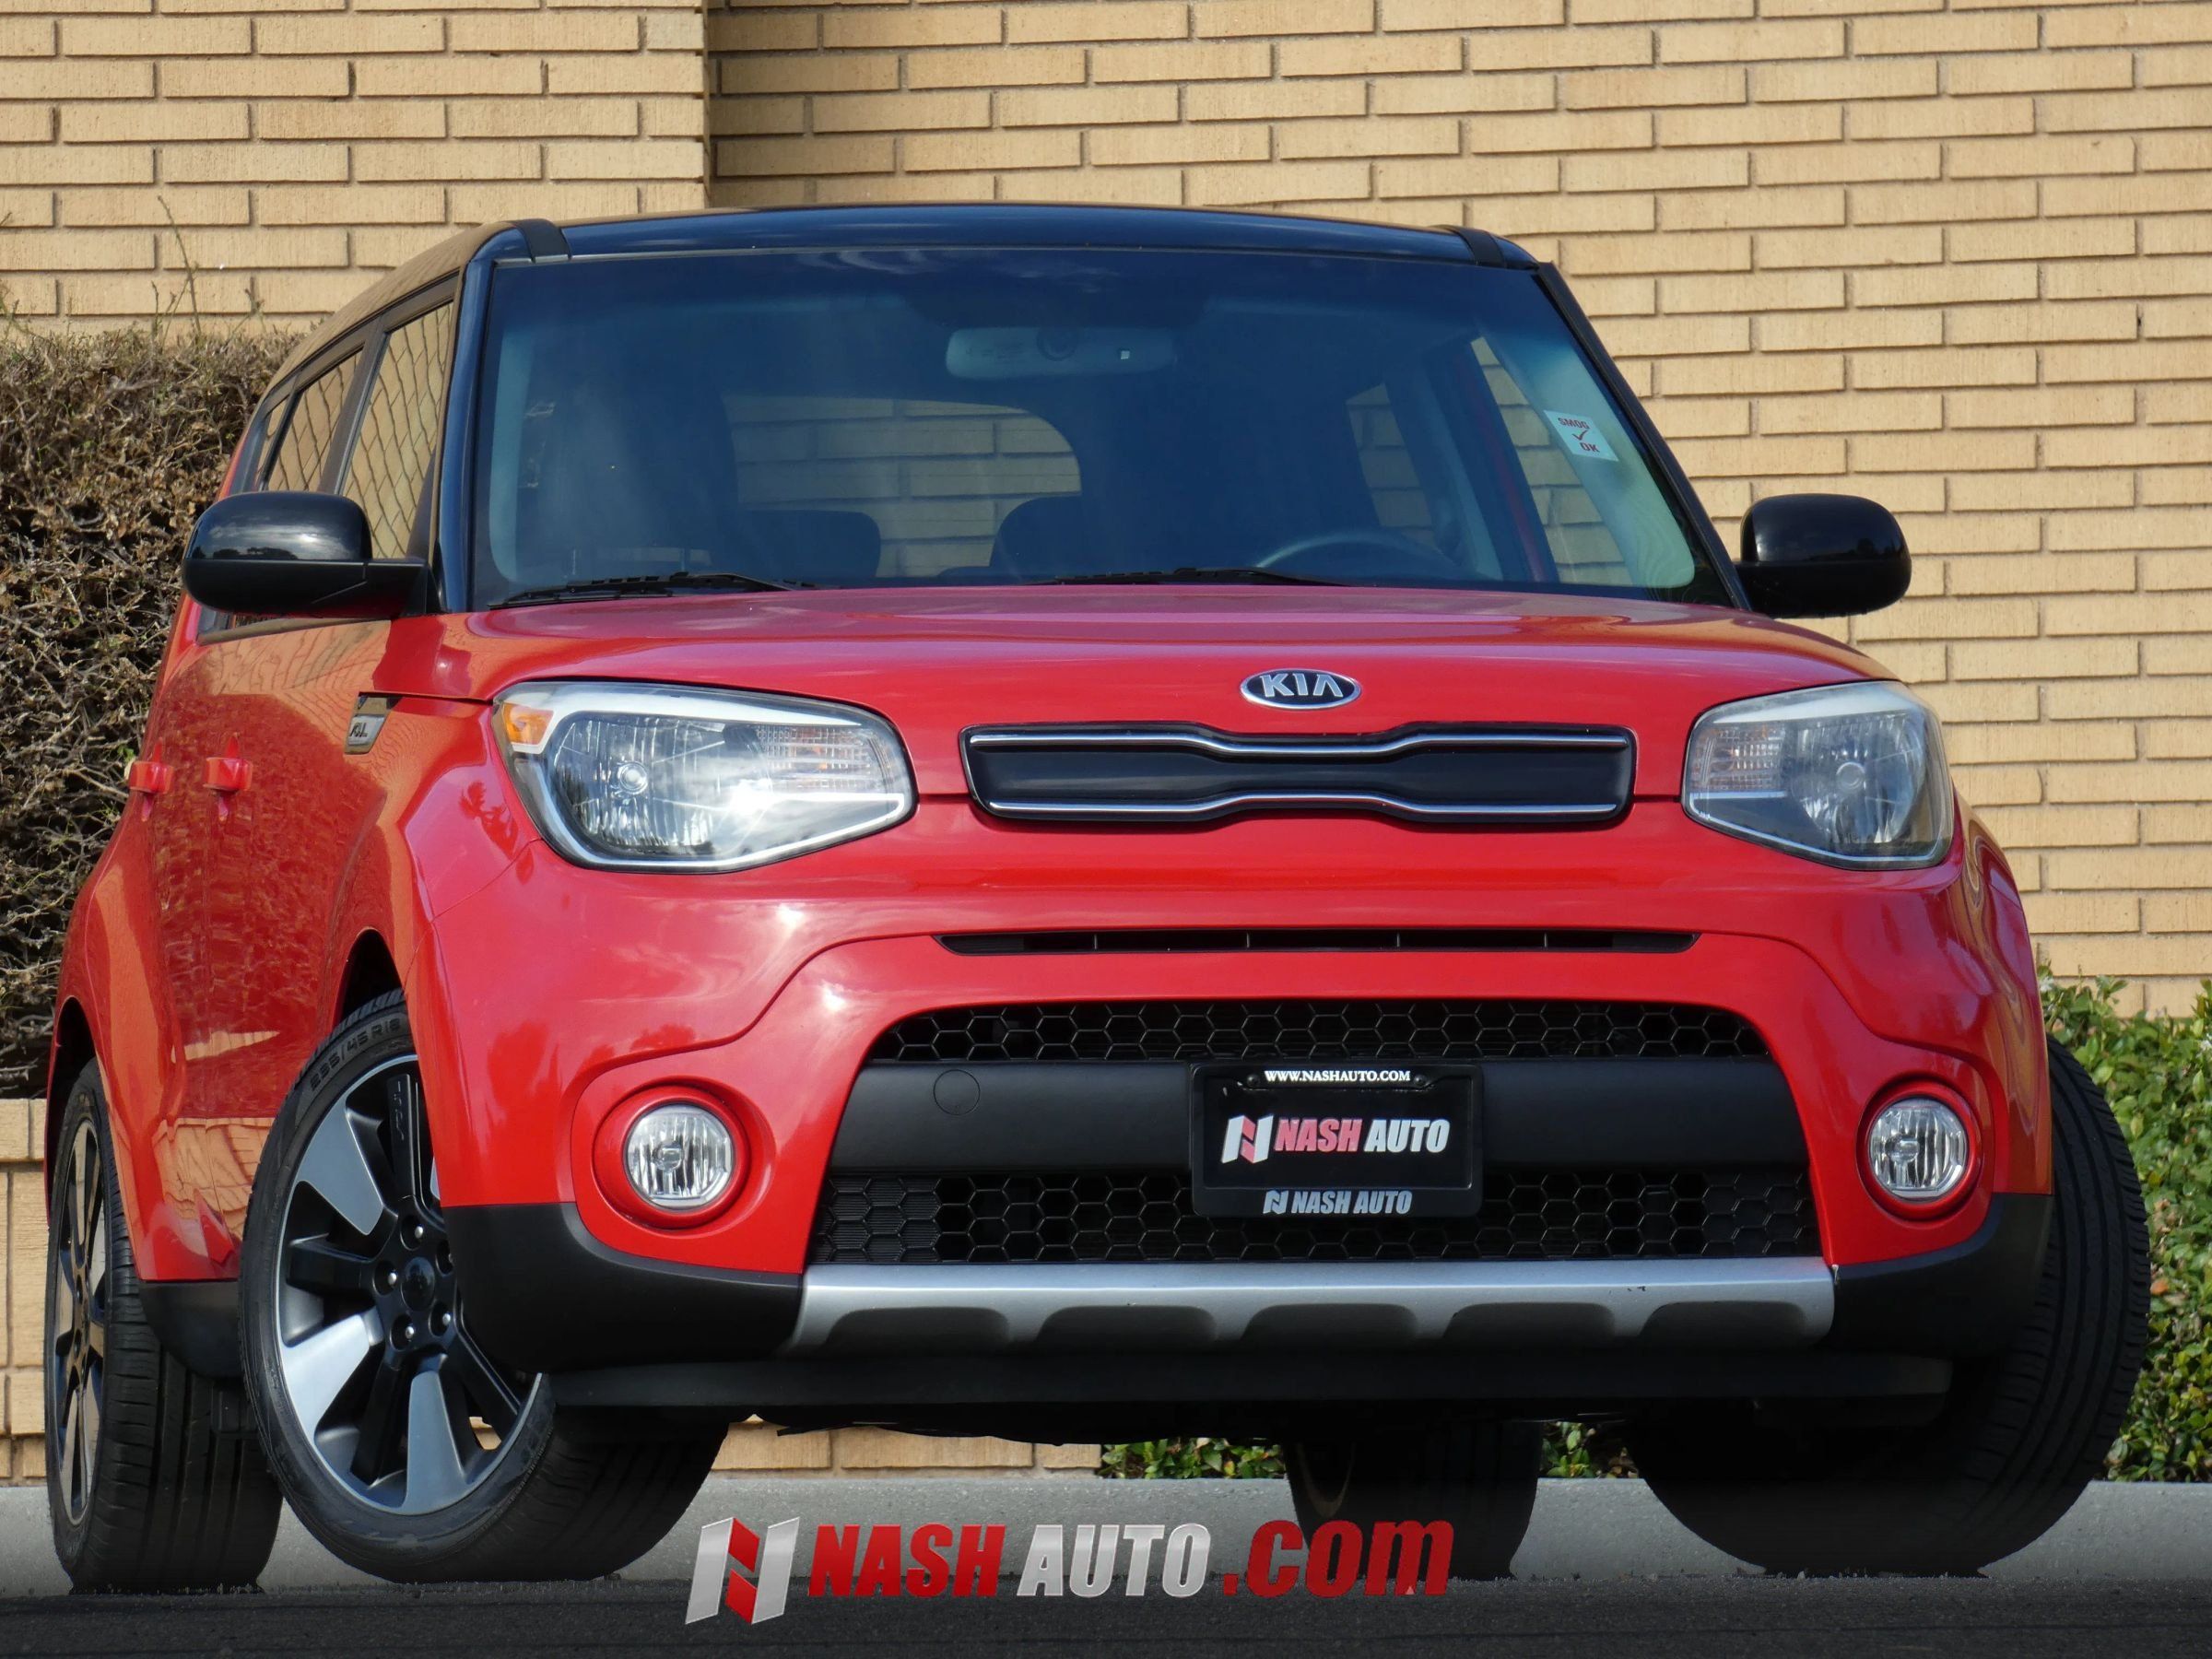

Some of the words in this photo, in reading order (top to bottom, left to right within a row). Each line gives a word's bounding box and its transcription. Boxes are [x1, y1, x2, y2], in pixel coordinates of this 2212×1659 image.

[1558, 418, 1591, 429] SMOG
[1580, 442, 1601, 453] OK
[1260, 673, 1344, 698] KIA
[1264, 1070, 1411, 1083] WWW.NASHAUTO.COM
[1274, 1118, 1363, 1153] NASH
[1364, 1119, 1451, 1154] AUTO
[1290, 1191, 1352, 1215] NASH
[1353, 1190, 1413, 1215] AUTO
